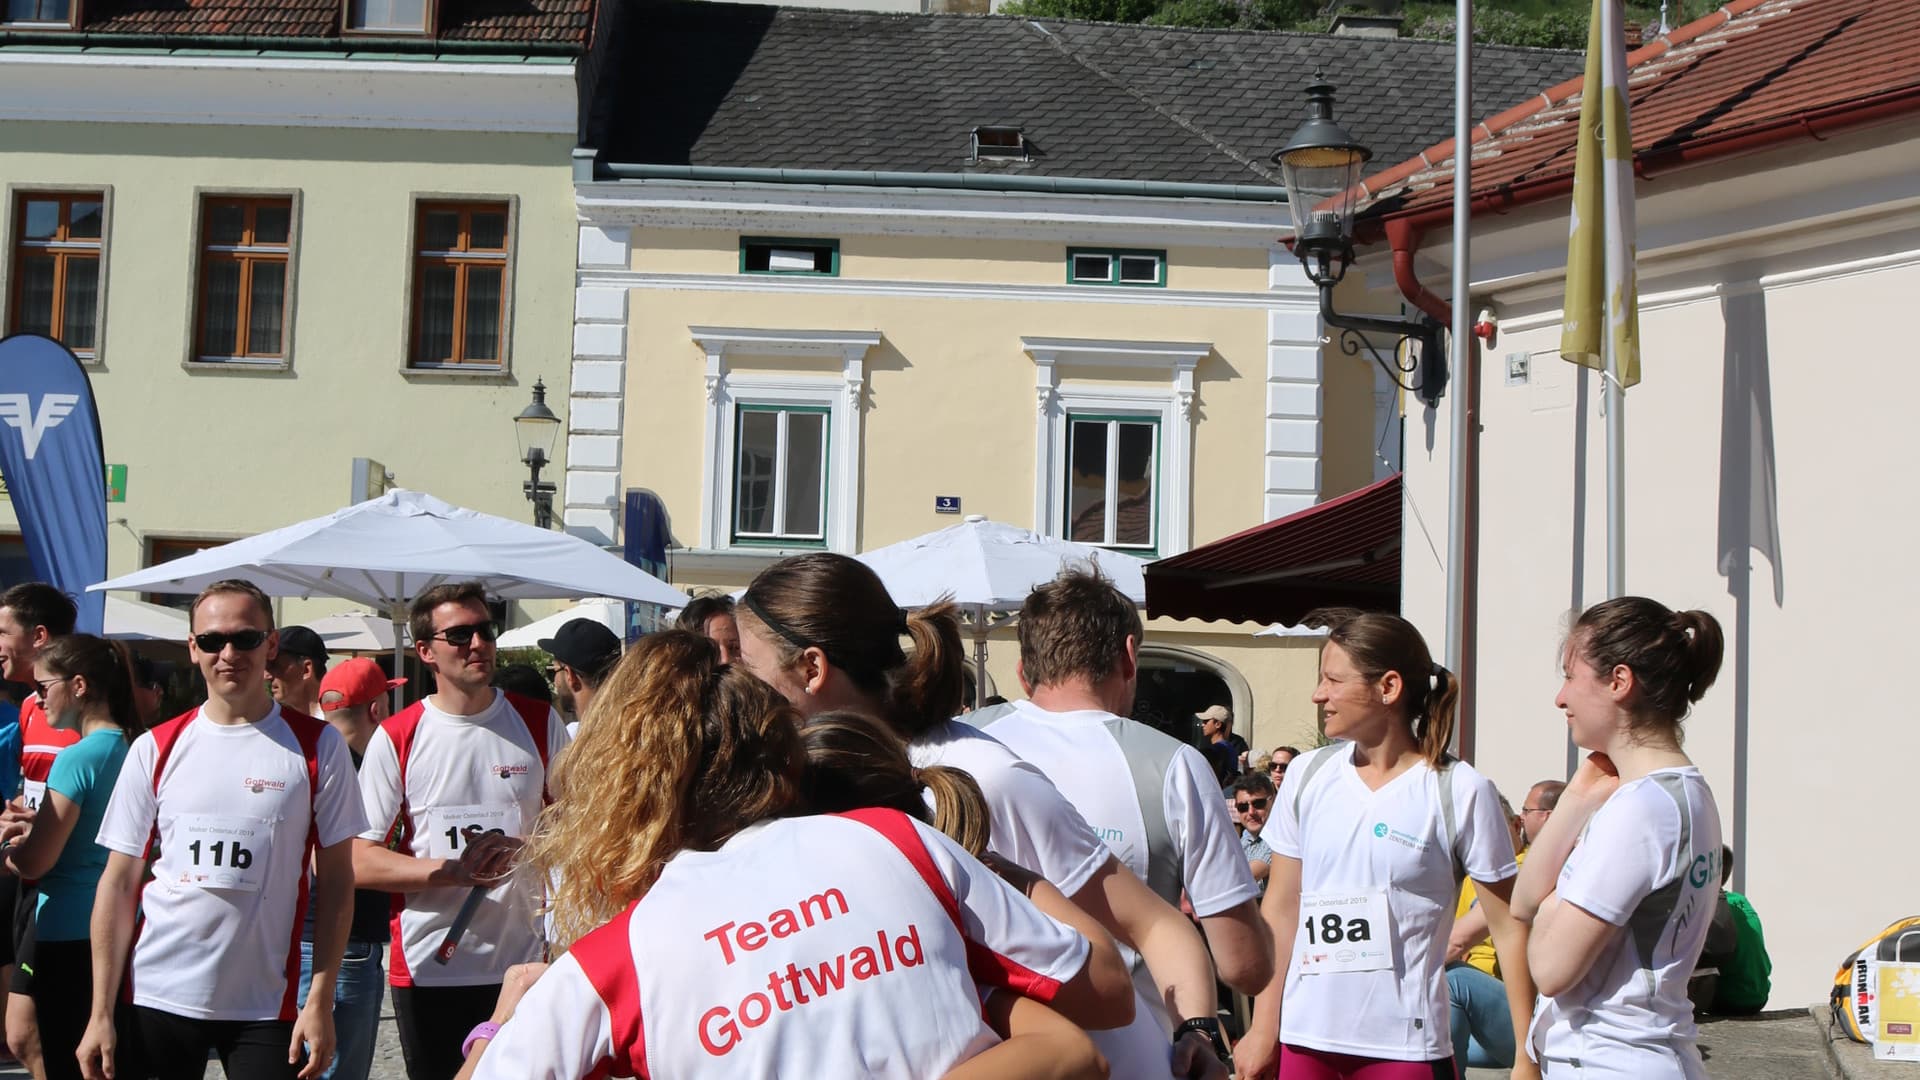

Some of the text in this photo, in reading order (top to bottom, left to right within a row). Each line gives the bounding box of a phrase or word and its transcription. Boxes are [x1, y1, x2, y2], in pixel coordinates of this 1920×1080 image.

[943, 498, 951, 507] 3
[245, 777, 286, 789] Gottwald
[238, 829, 255, 837] 2019
[1092, 826, 1124, 842] um
[189, 839, 253, 870] 11b
[1350, 896, 1368, 905] 2019
[703, 887, 850, 966] Team
[1305, 913, 1371, 945] 18a
[698, 924, 925, 1057] Gottwald
[1856, 959, 1870, 1025] IRONMAN
